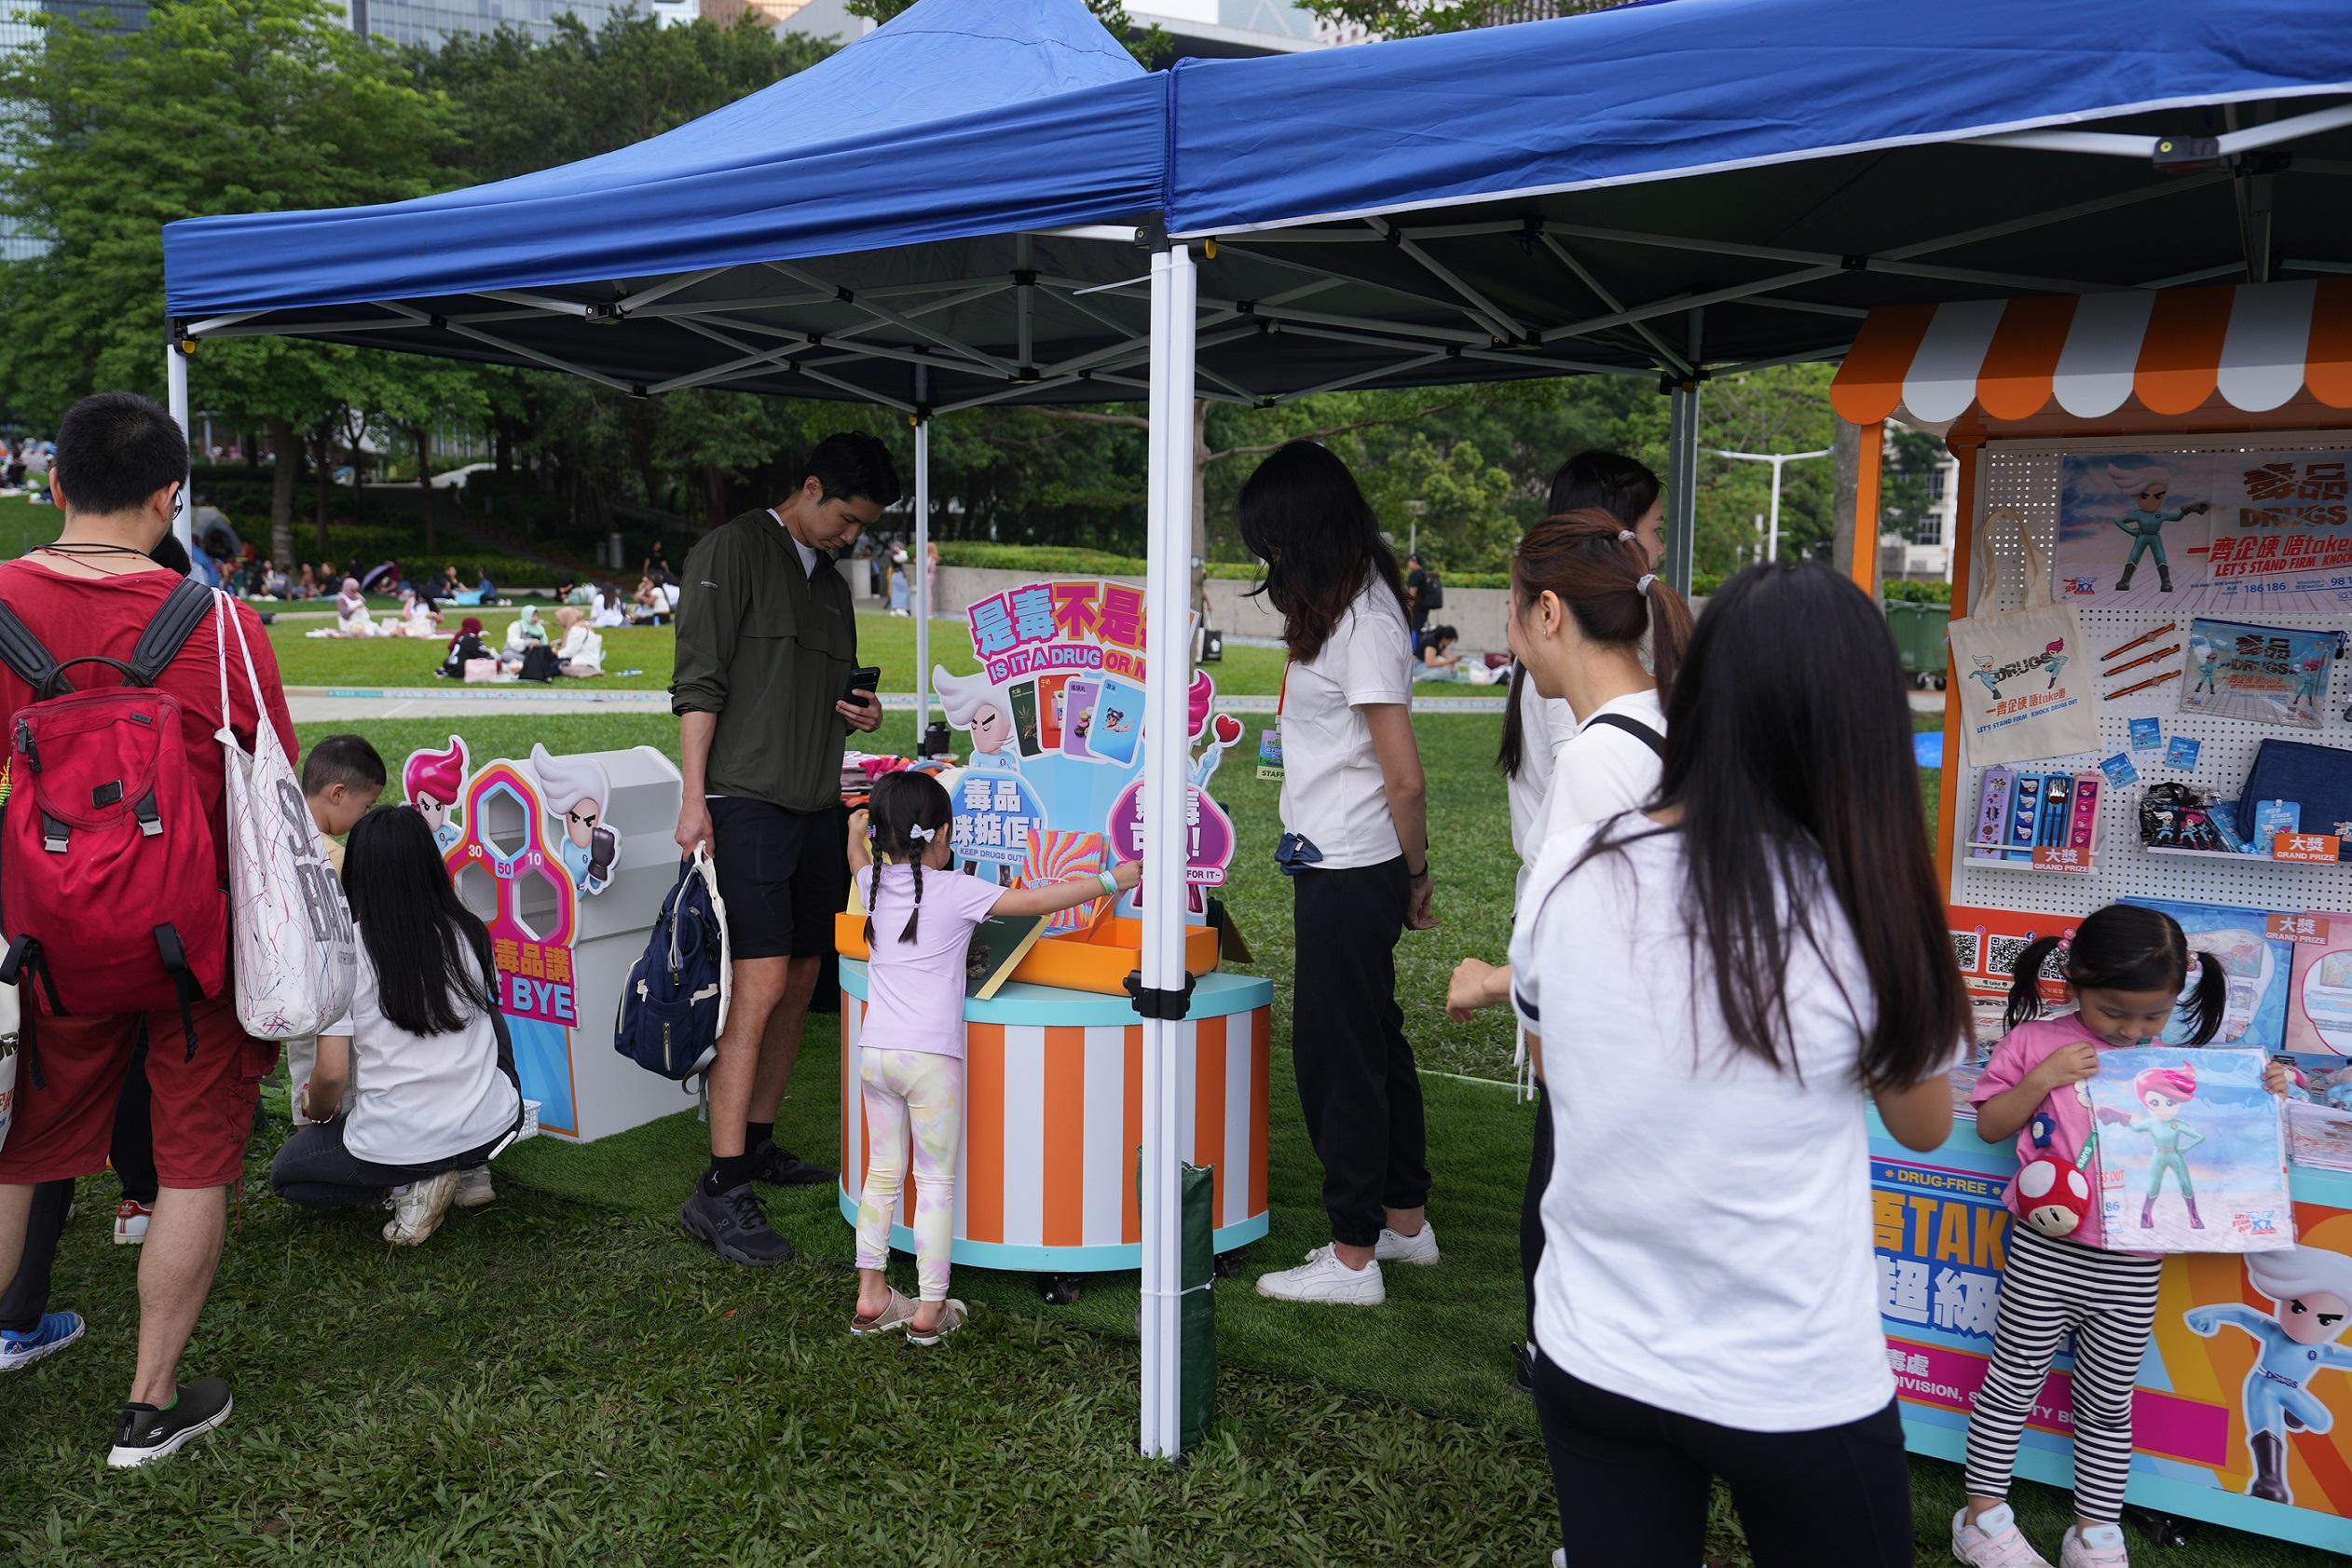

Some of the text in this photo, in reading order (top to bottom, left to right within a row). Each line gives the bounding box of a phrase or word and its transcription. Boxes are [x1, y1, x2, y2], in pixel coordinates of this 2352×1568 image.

[2240, 505, 2348, 528] DRUGS
[2283, 534, 2352, 556] 唔take
[2215, 552, 2352, 578] LET'S STAND FIRM KNOC
[2245, 584, 2264, 593] 186
[2266, 581, 2287, 592] 186
[2331, 577, 2345, 586] 98
[973, 584, 1146, 656] 是毒不是
[991, 662, 1008, 681] IS
[1010, 653, 1029, 673] IT
[1033, 652, 1046, 667] A
[1051, 648, 1101, 665] DRUG
[1105, 651, 1131, 674] OR
[1994, 651, 2056, 682] DRUGS
[1992, 718, 2013, 729] STAND
[2013, 714, 2029, 723] FIRM
[2031, 708, 2050, 717] KNOCK
[2068, 699, 2078, 707] OUT
[1262, 770, 1285, 779] STAFF
[964, 779, 1021, 812] 毒品
[468, 843, 542, 866] 30 10
[960, 847, 1024, 863] KEEP DRUGS OUT
[2289, 836, 2324, 852] 大獎
[2033, 863, 2063, 871] GRAND
[2044, 848, 2078, 865] 大獎
[2277, 852, 2335, 862] GRAND PRIZE
[498, 861, 512, 876] 50
[2279, 917, 2316, 935] 大獎
[2265, 932, 2327, 945] GRAND PRIZE
[513, 976, 574, 1020] BYE
[1897, 1169, 1988, 1195] DRUG-FREE
[2105, 1201, 2120, 1211] 86
[1877, 1254, 2002, 1338] 超級
[1886, 1348, 1930, 1378] 毒處
[1894, 1374, 1963, 1402] DIVISION,
